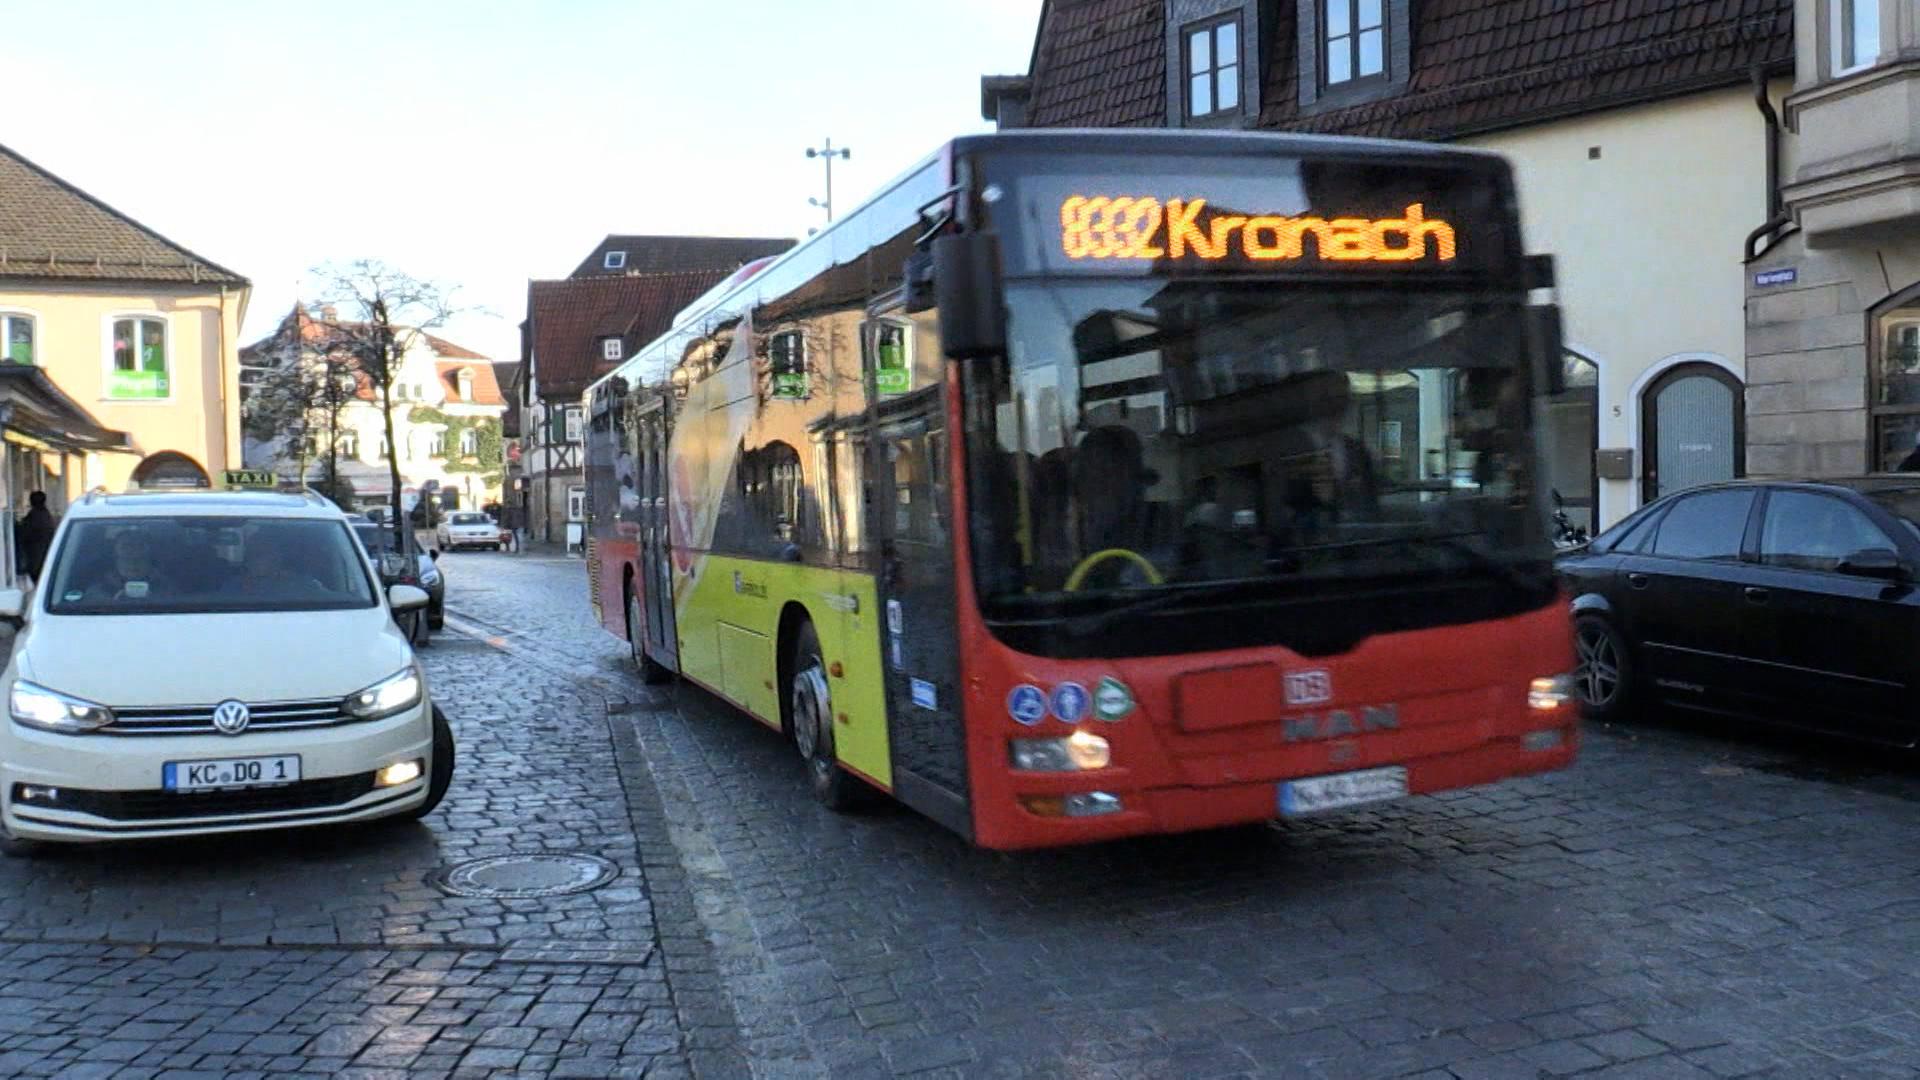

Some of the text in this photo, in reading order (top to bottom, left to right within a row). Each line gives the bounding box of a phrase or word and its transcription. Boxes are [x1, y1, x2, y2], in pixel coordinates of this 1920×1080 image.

[1166, 198, 1456, 260] Kronach
[231, 472, 268, 483] TAXI
[189, 765, 217, 785] KC
[275, 759, 287, 778] 1
